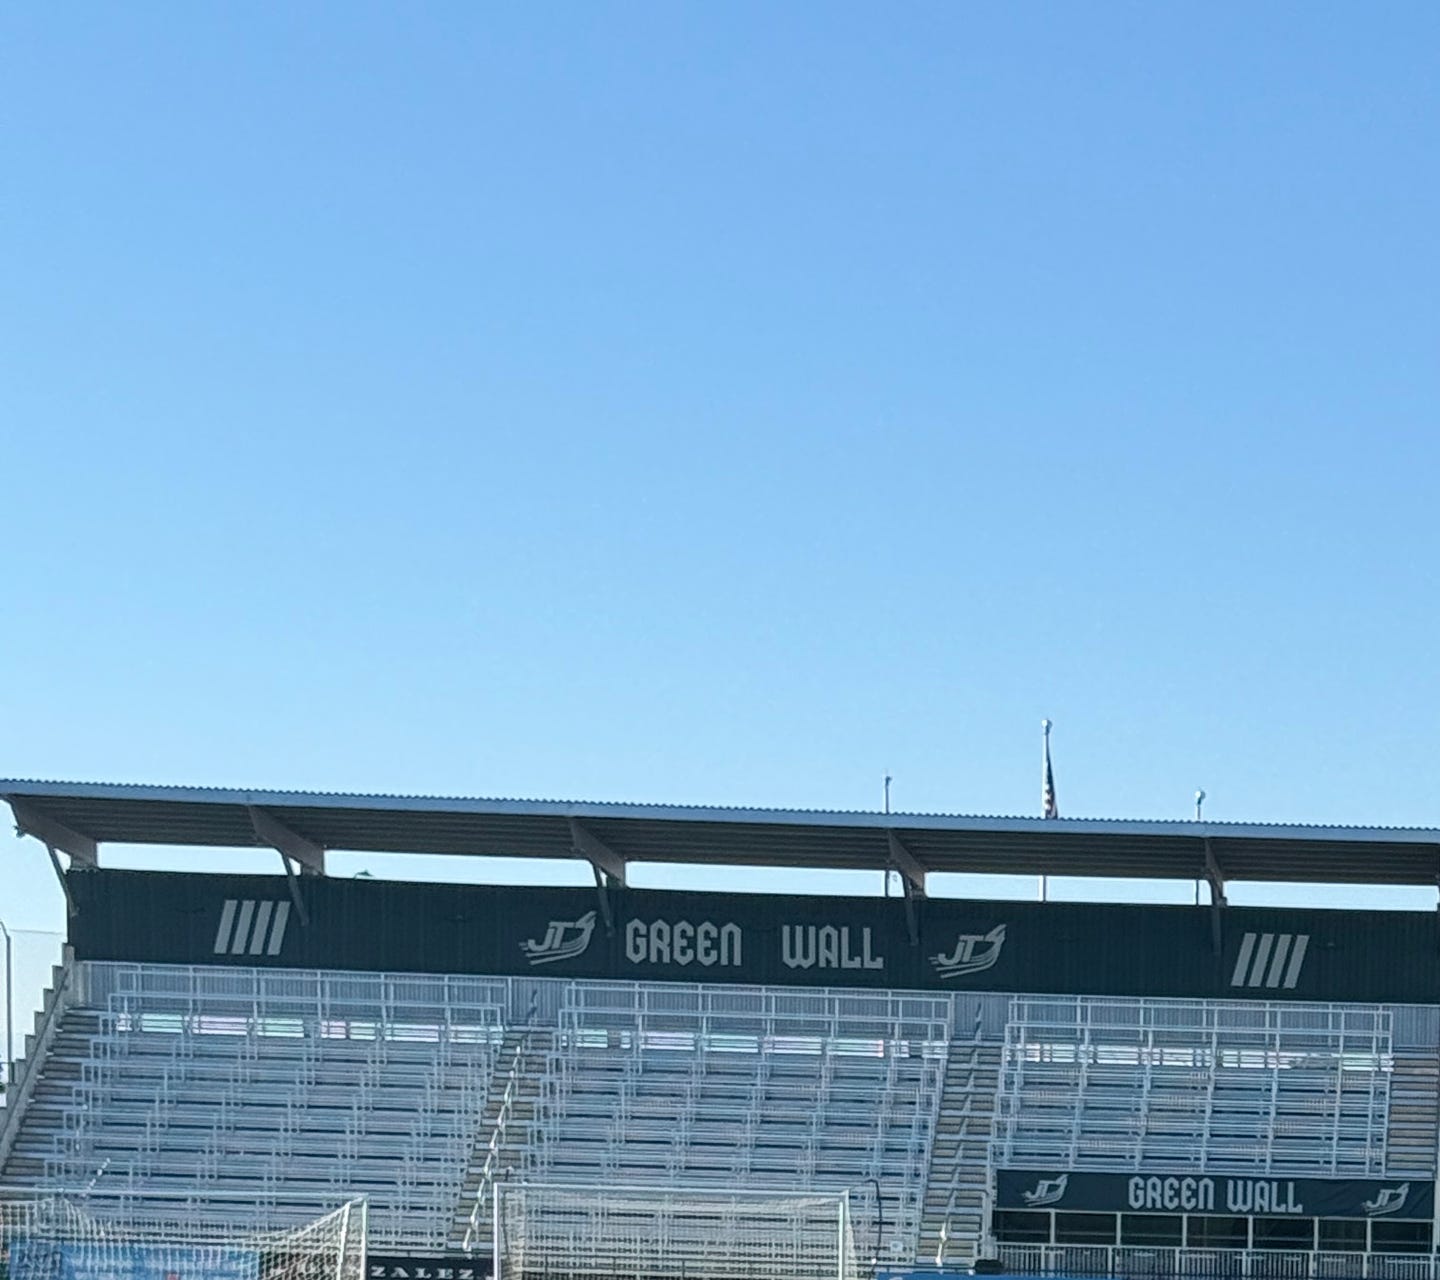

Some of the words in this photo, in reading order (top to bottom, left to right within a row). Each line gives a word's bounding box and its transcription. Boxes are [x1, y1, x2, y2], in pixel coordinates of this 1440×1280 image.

[626, 918, 742, 967] GREEN
[782, 924, 884, 969] WALL
[1128, 1176, 1213, 1211] GREEN
[1227, 1180, 1303, 1213] WALL
